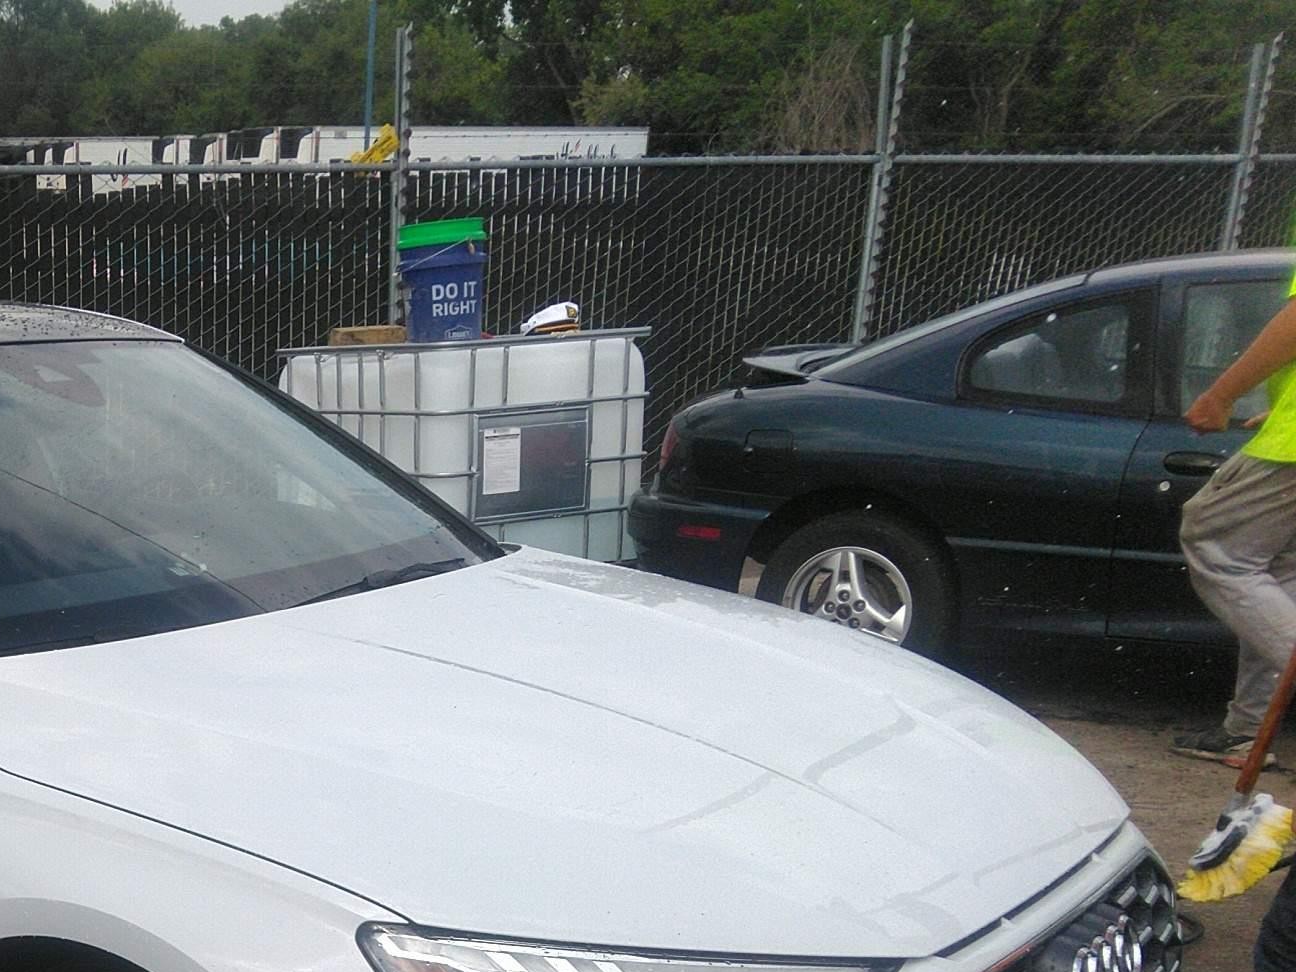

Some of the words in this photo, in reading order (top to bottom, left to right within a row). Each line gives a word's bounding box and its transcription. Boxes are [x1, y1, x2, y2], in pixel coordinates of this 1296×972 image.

[432, 282, 458, 301] DO
[464, 281, 477, 298] IT
[432, 300, 477, 317] RIGHT
